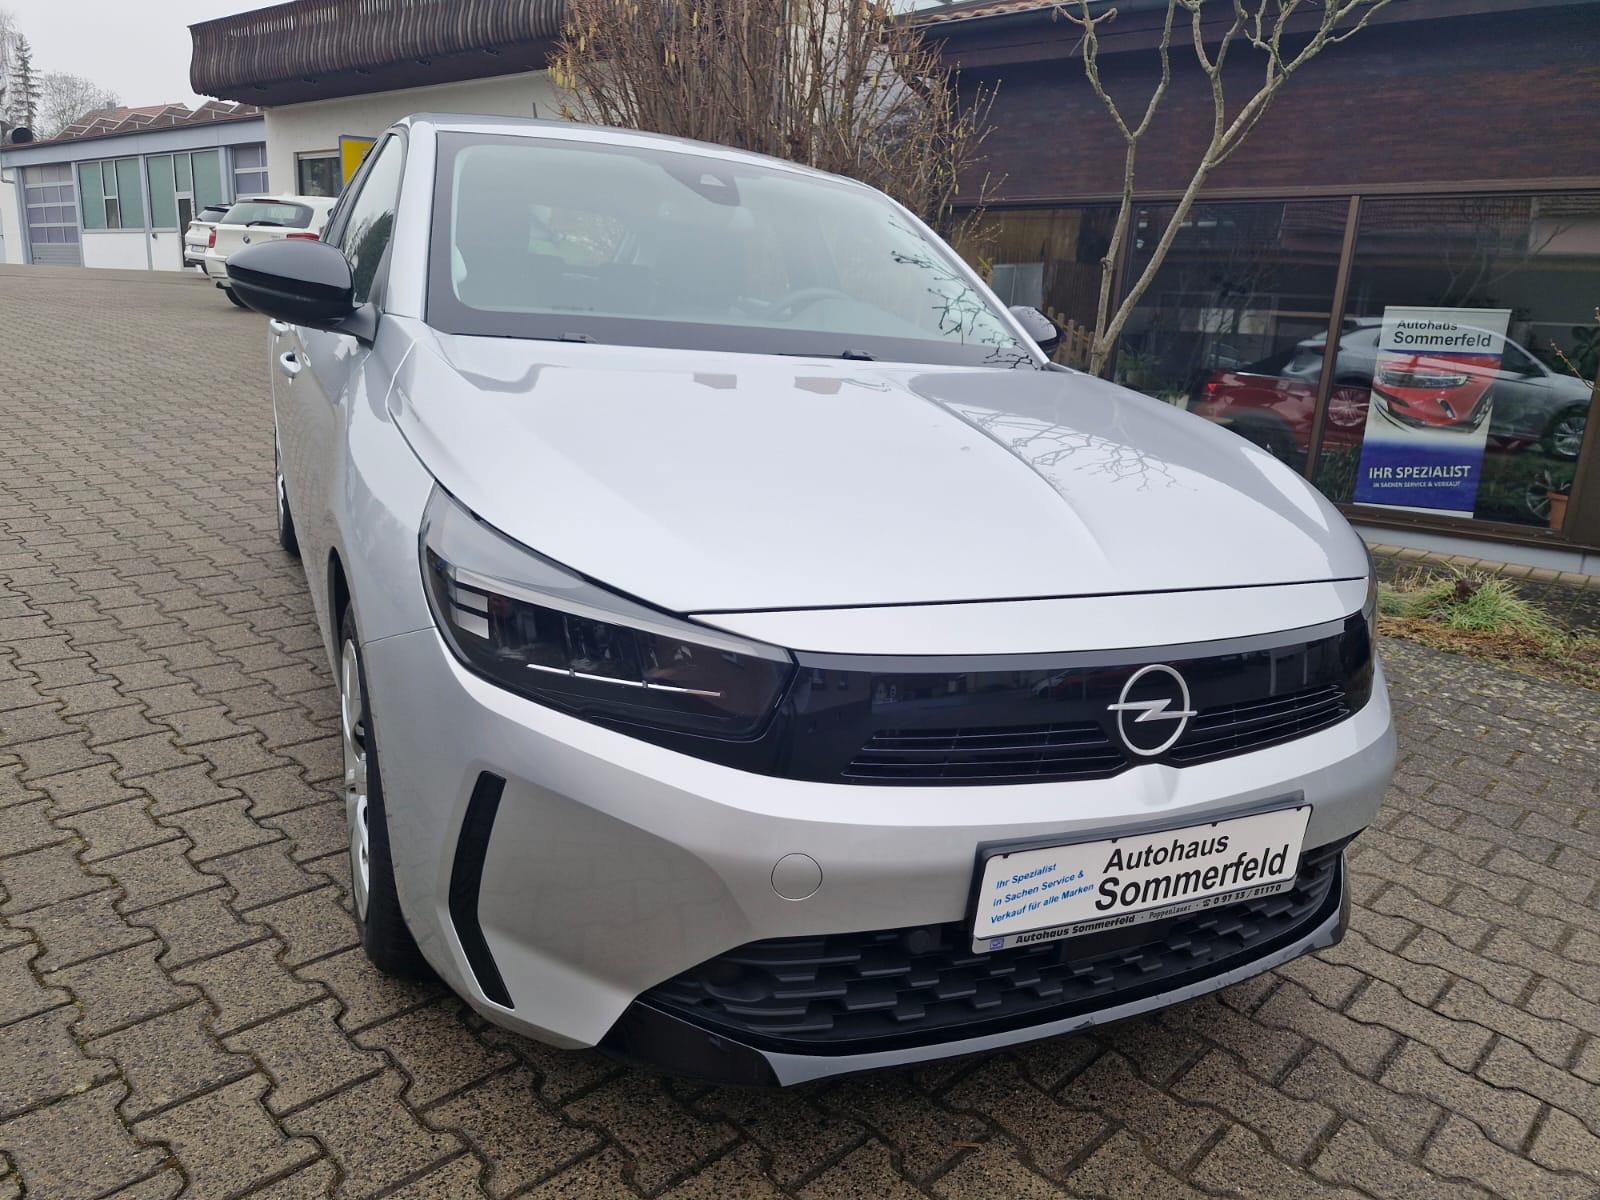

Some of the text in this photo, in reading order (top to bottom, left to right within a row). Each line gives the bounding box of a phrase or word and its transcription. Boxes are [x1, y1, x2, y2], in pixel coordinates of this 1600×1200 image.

[1393, 331, 1491, 347] Sommerfeld
[1396, 319, 1458, 331] Autohaus
[1369, 465, 1472, 479] IHR SPEZIALIST
[1102, 834, 1230, 874] Autohaus
[993, 869, 1084, 908] in Sachen Service &
[995, 863, 1057, 889] Ihr Spezialist
[1094, 843, 1289, 911] Sommerfeld
[991, 883, 1094, 924] Verkauf für alle Marken
[1015, 927, 1070, 944] Autohaus
[1071, 914, 1136, 934] Sommerfeld
